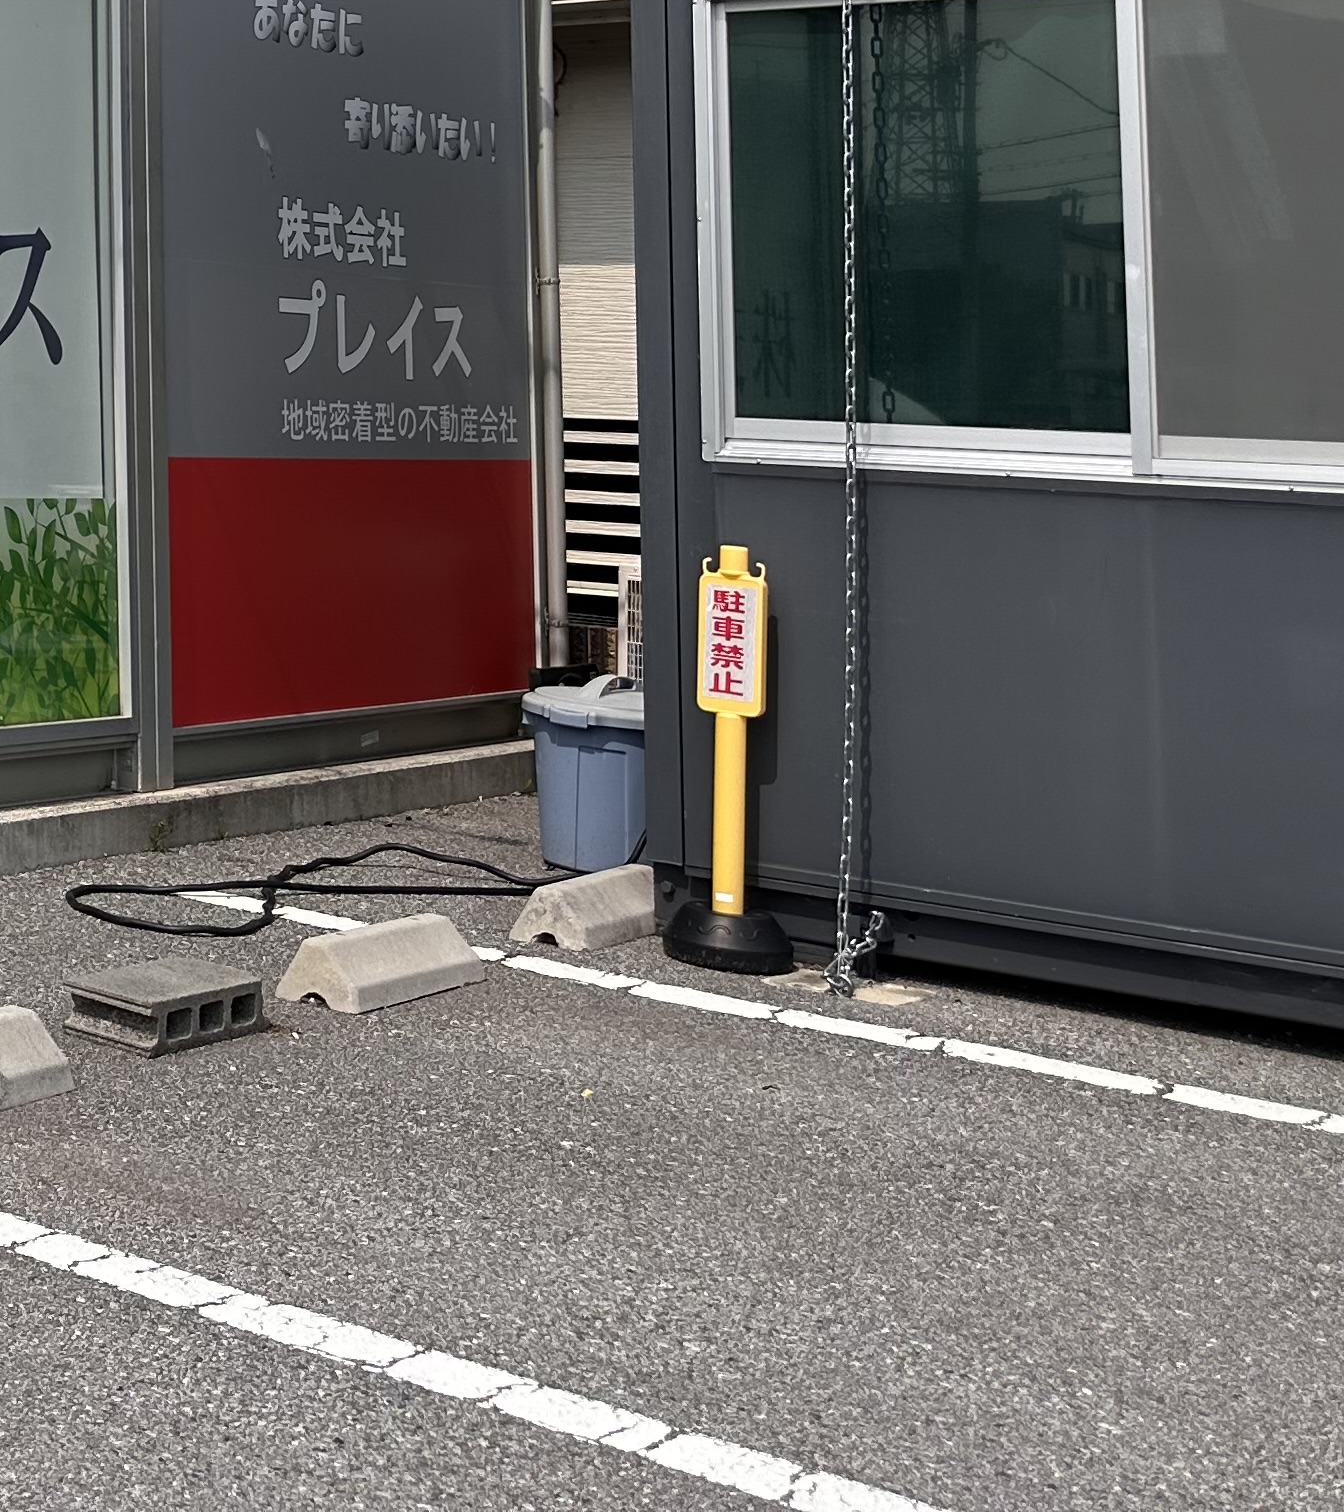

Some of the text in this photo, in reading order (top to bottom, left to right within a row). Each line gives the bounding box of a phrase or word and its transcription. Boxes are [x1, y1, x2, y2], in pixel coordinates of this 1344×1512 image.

[278, 196, 407, 267] 株式会社
[278, 279, 473, 380] プレイス
[281, 398, 519, 444] 地域密着型の不動産会社
[709, 590, 746, 697] 駐車禁止
